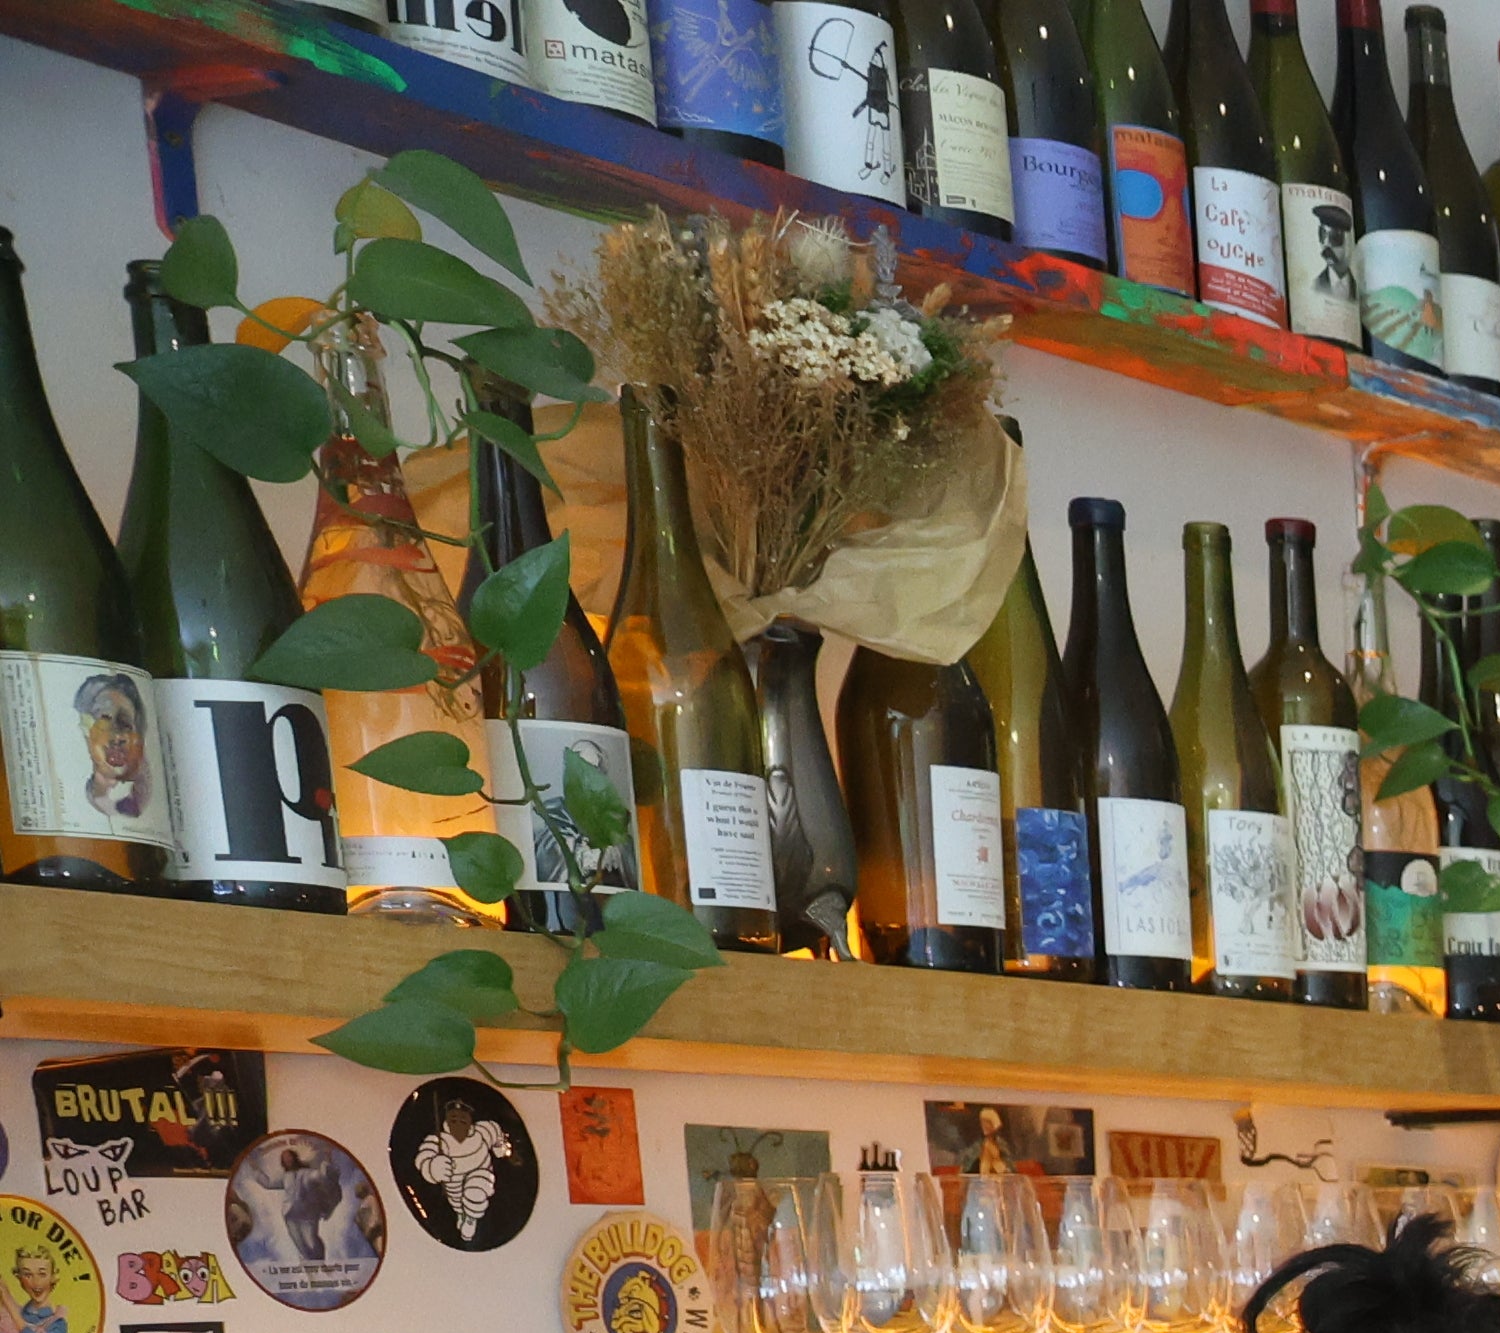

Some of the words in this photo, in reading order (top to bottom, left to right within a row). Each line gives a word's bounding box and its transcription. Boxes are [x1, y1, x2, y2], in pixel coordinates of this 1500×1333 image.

[54, 1083, 197, 1127] BRUTAL
[44, 1165, 124, 1196] LOUP
[98, 1188, 151, 1227] BAR
[10, 1206, 43, 1231] OR
[46, 1219, 84, 1266] DIE
[582, 1219, 698, 1286] BULLDOG
[567, 1258, 603, 1332] THE
